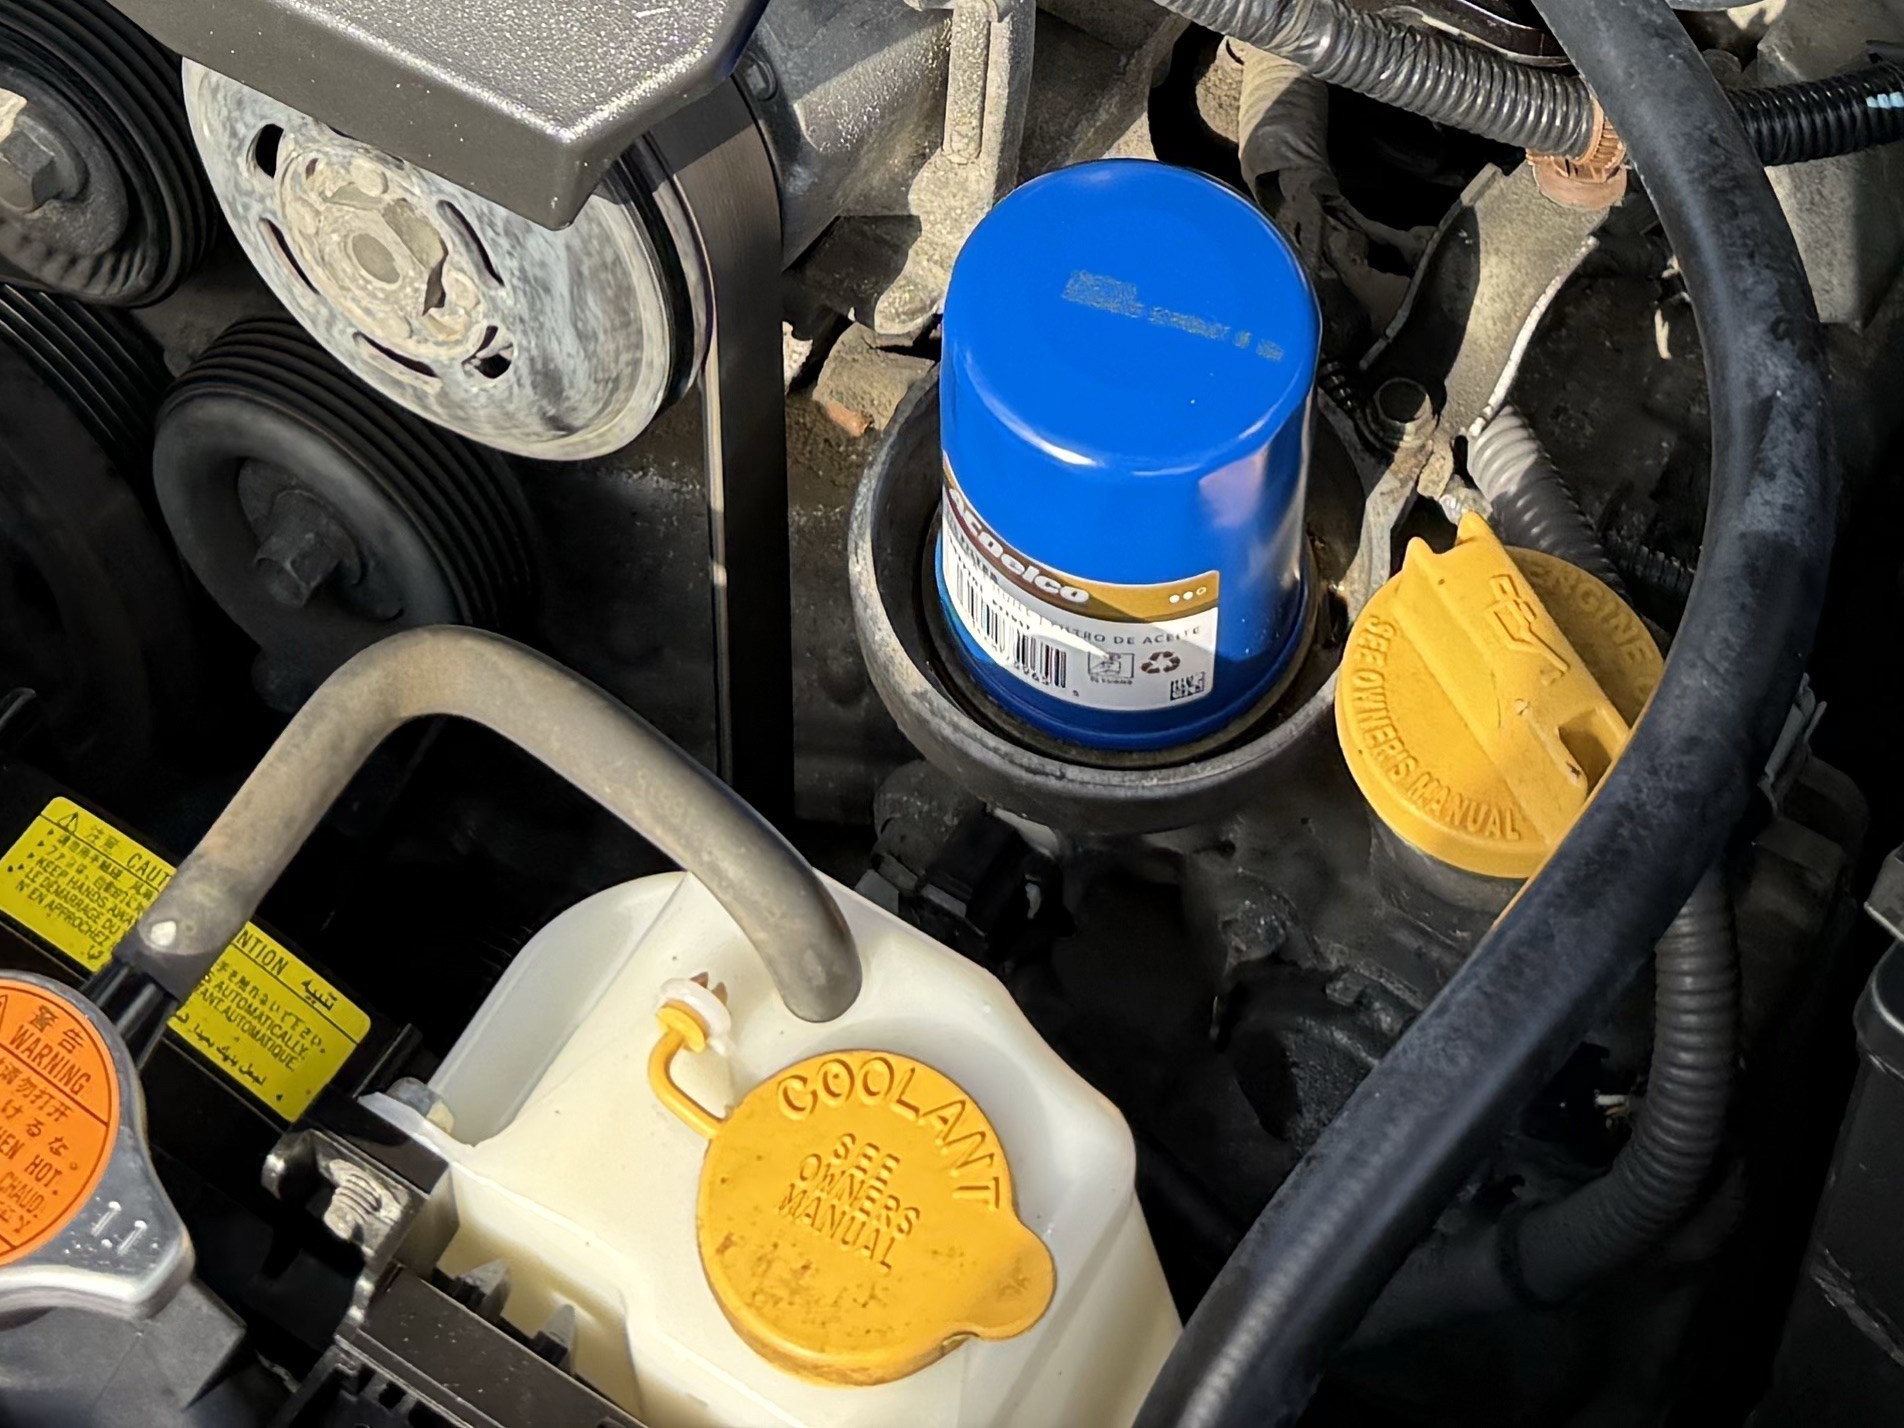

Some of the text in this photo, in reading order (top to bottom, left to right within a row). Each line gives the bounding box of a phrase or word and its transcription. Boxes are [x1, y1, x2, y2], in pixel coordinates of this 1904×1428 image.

[1113, 635, 1135, 645] DE
[1357, 616, 1396, 668] SEE
[1407, 771, 1522, 841] MANUAL
[125, 850, 173, 889] CAUT
[107, 901, 137, 927] AWA
[234, 930, 287, 977] NTION
[27, 1002, 90, 1058] 警告
[7, 1023, 93, 1098] WARNING
[776, 1056, 1001, 1211] COOLANT
[832, 1132, 900, 1189] SEE
[23, 1152, 69, 1196] HOT.
[798, 1153, 921, 1238] OWNERS
[778, 1182, 897, 1272] MANUAL
